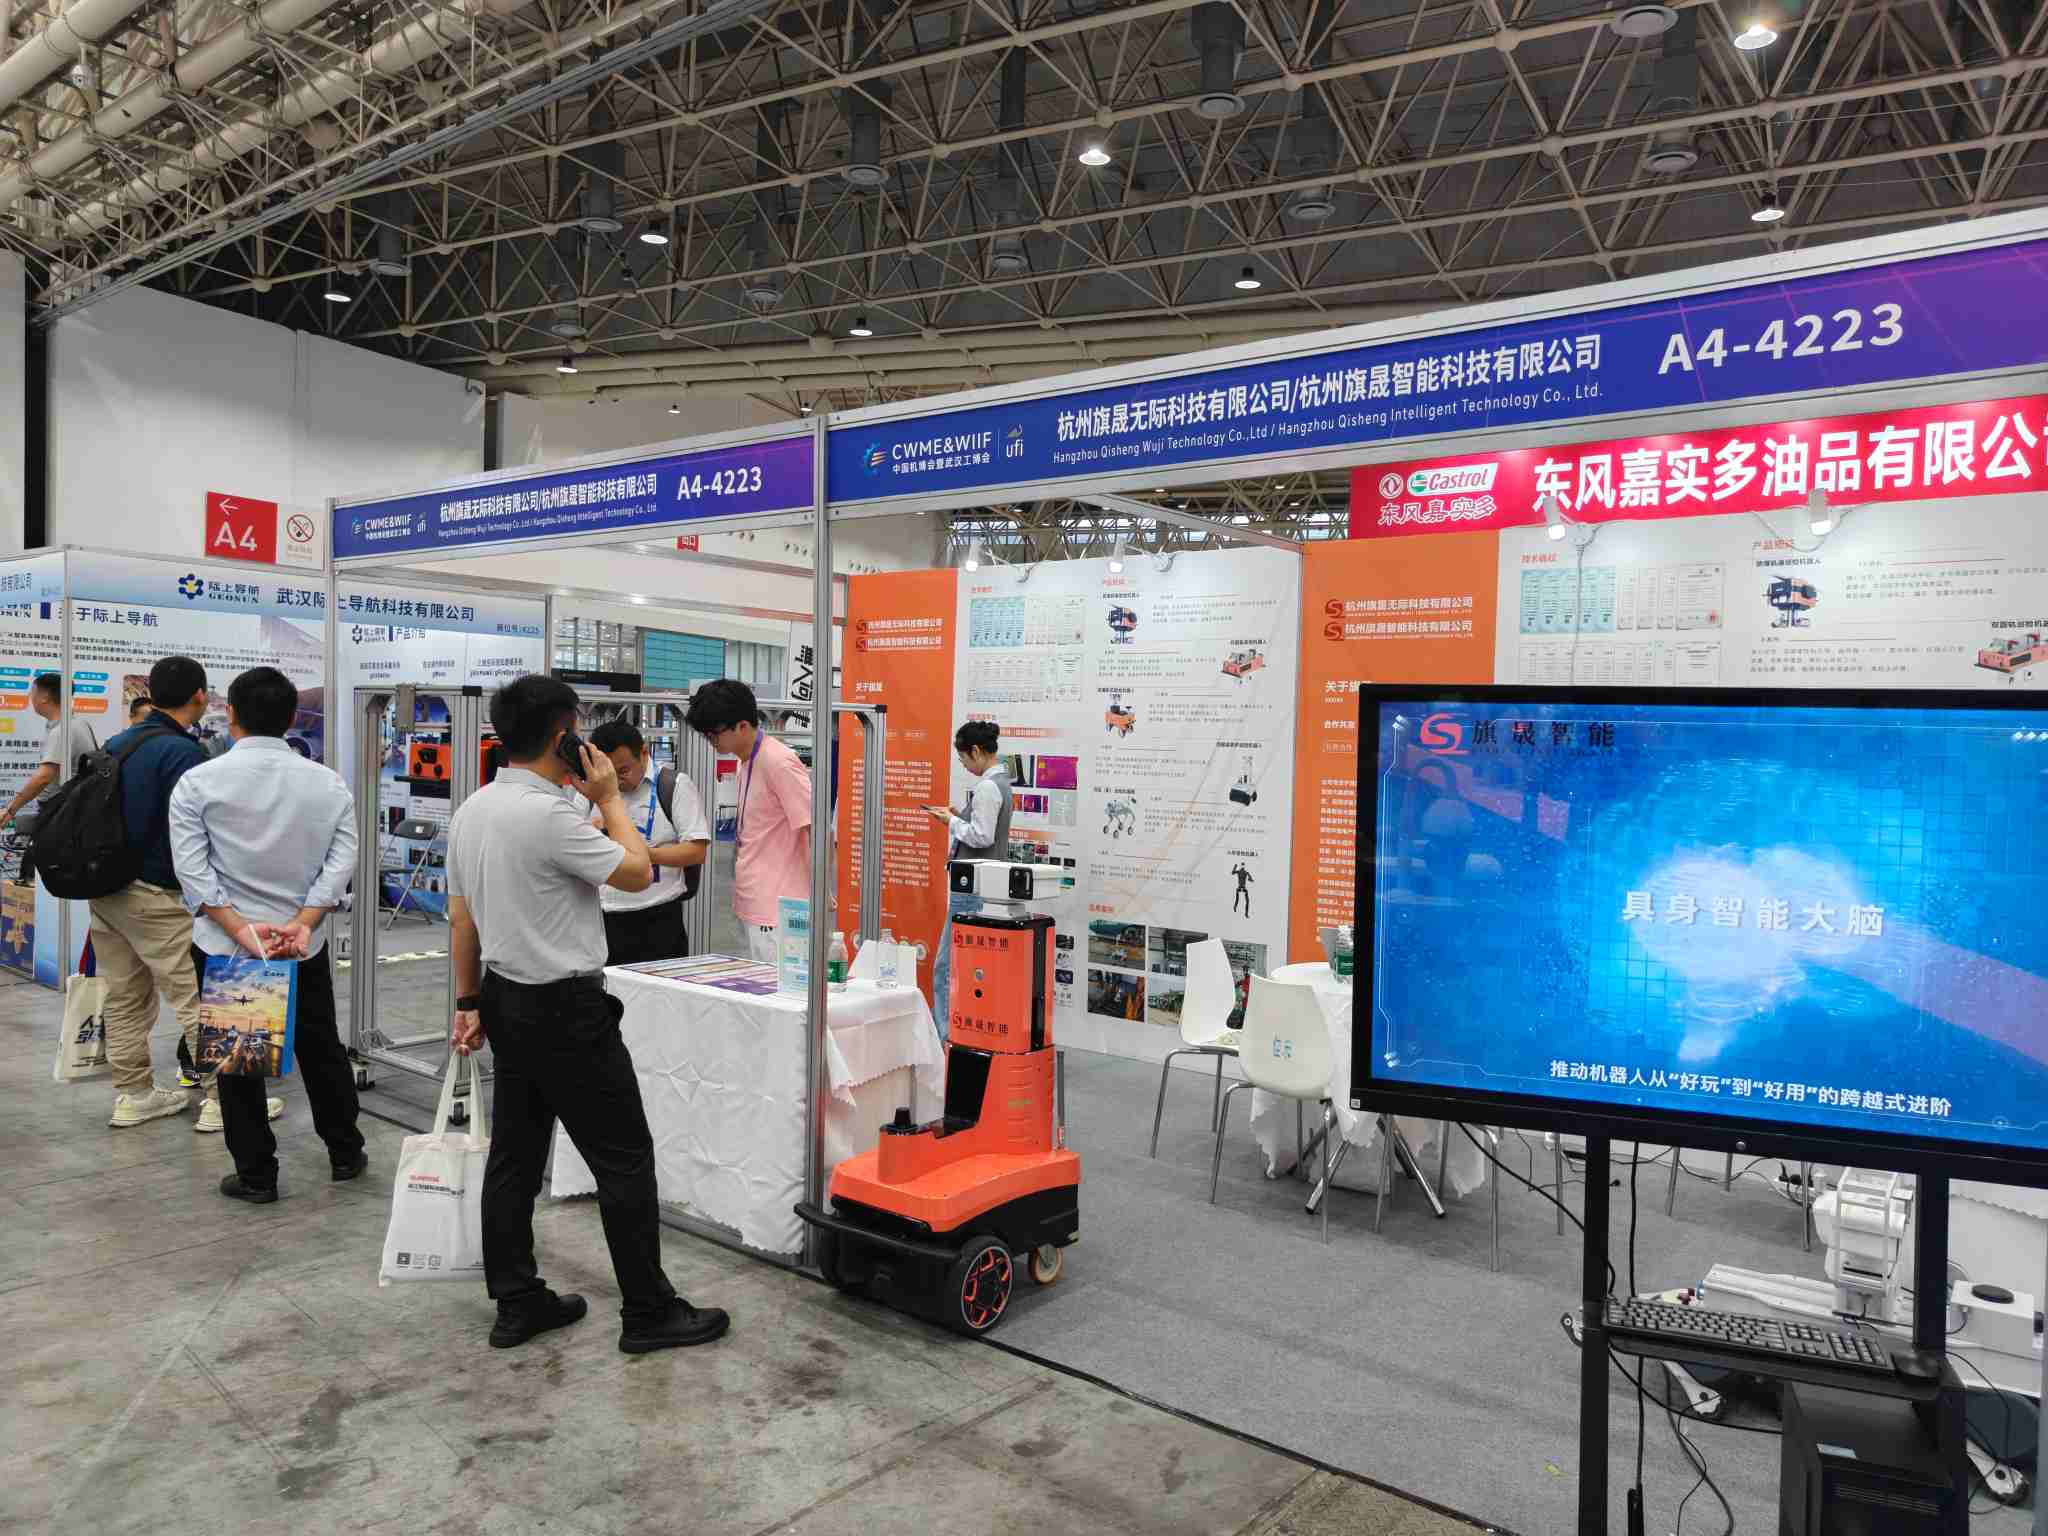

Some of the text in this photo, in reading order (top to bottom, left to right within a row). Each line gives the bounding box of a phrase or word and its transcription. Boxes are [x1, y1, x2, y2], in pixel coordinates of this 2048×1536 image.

[1658, 302, 1904, 376] A4-4223
[1053, 447, 1099, 465] Hangzhou
[1101, 442, 1140, 458] Qisheng
[1143, 436, 1165, 455] Wuji
[1167, 430, 1226, 450] Technology
[1278, 414, 1335, 437] Hangzhou
[1338, 411, 1388, 430] Qisheng
[1391, 401, 1458, 423] Intelligent
[1461, 391, 1539, 414] Technology
[892, 431, 1024, 460] CWME&WIIF ufi
[1532, 411, 2048, 512] 东风嘉实多油品有限公
[677, 466, 763, 501] A4-4223
[1428, 468, 1489, 491] Castrol
[364, 513, 412, 531] CWME&WIIF
[1377, 494, 1497, 527] 东风嘉实多
[213, 520, 258, 552] A4
[1473, 719, 1615, 747] 旗晟智能
[1621, 890, 1884, 937] 具身智能大脑
